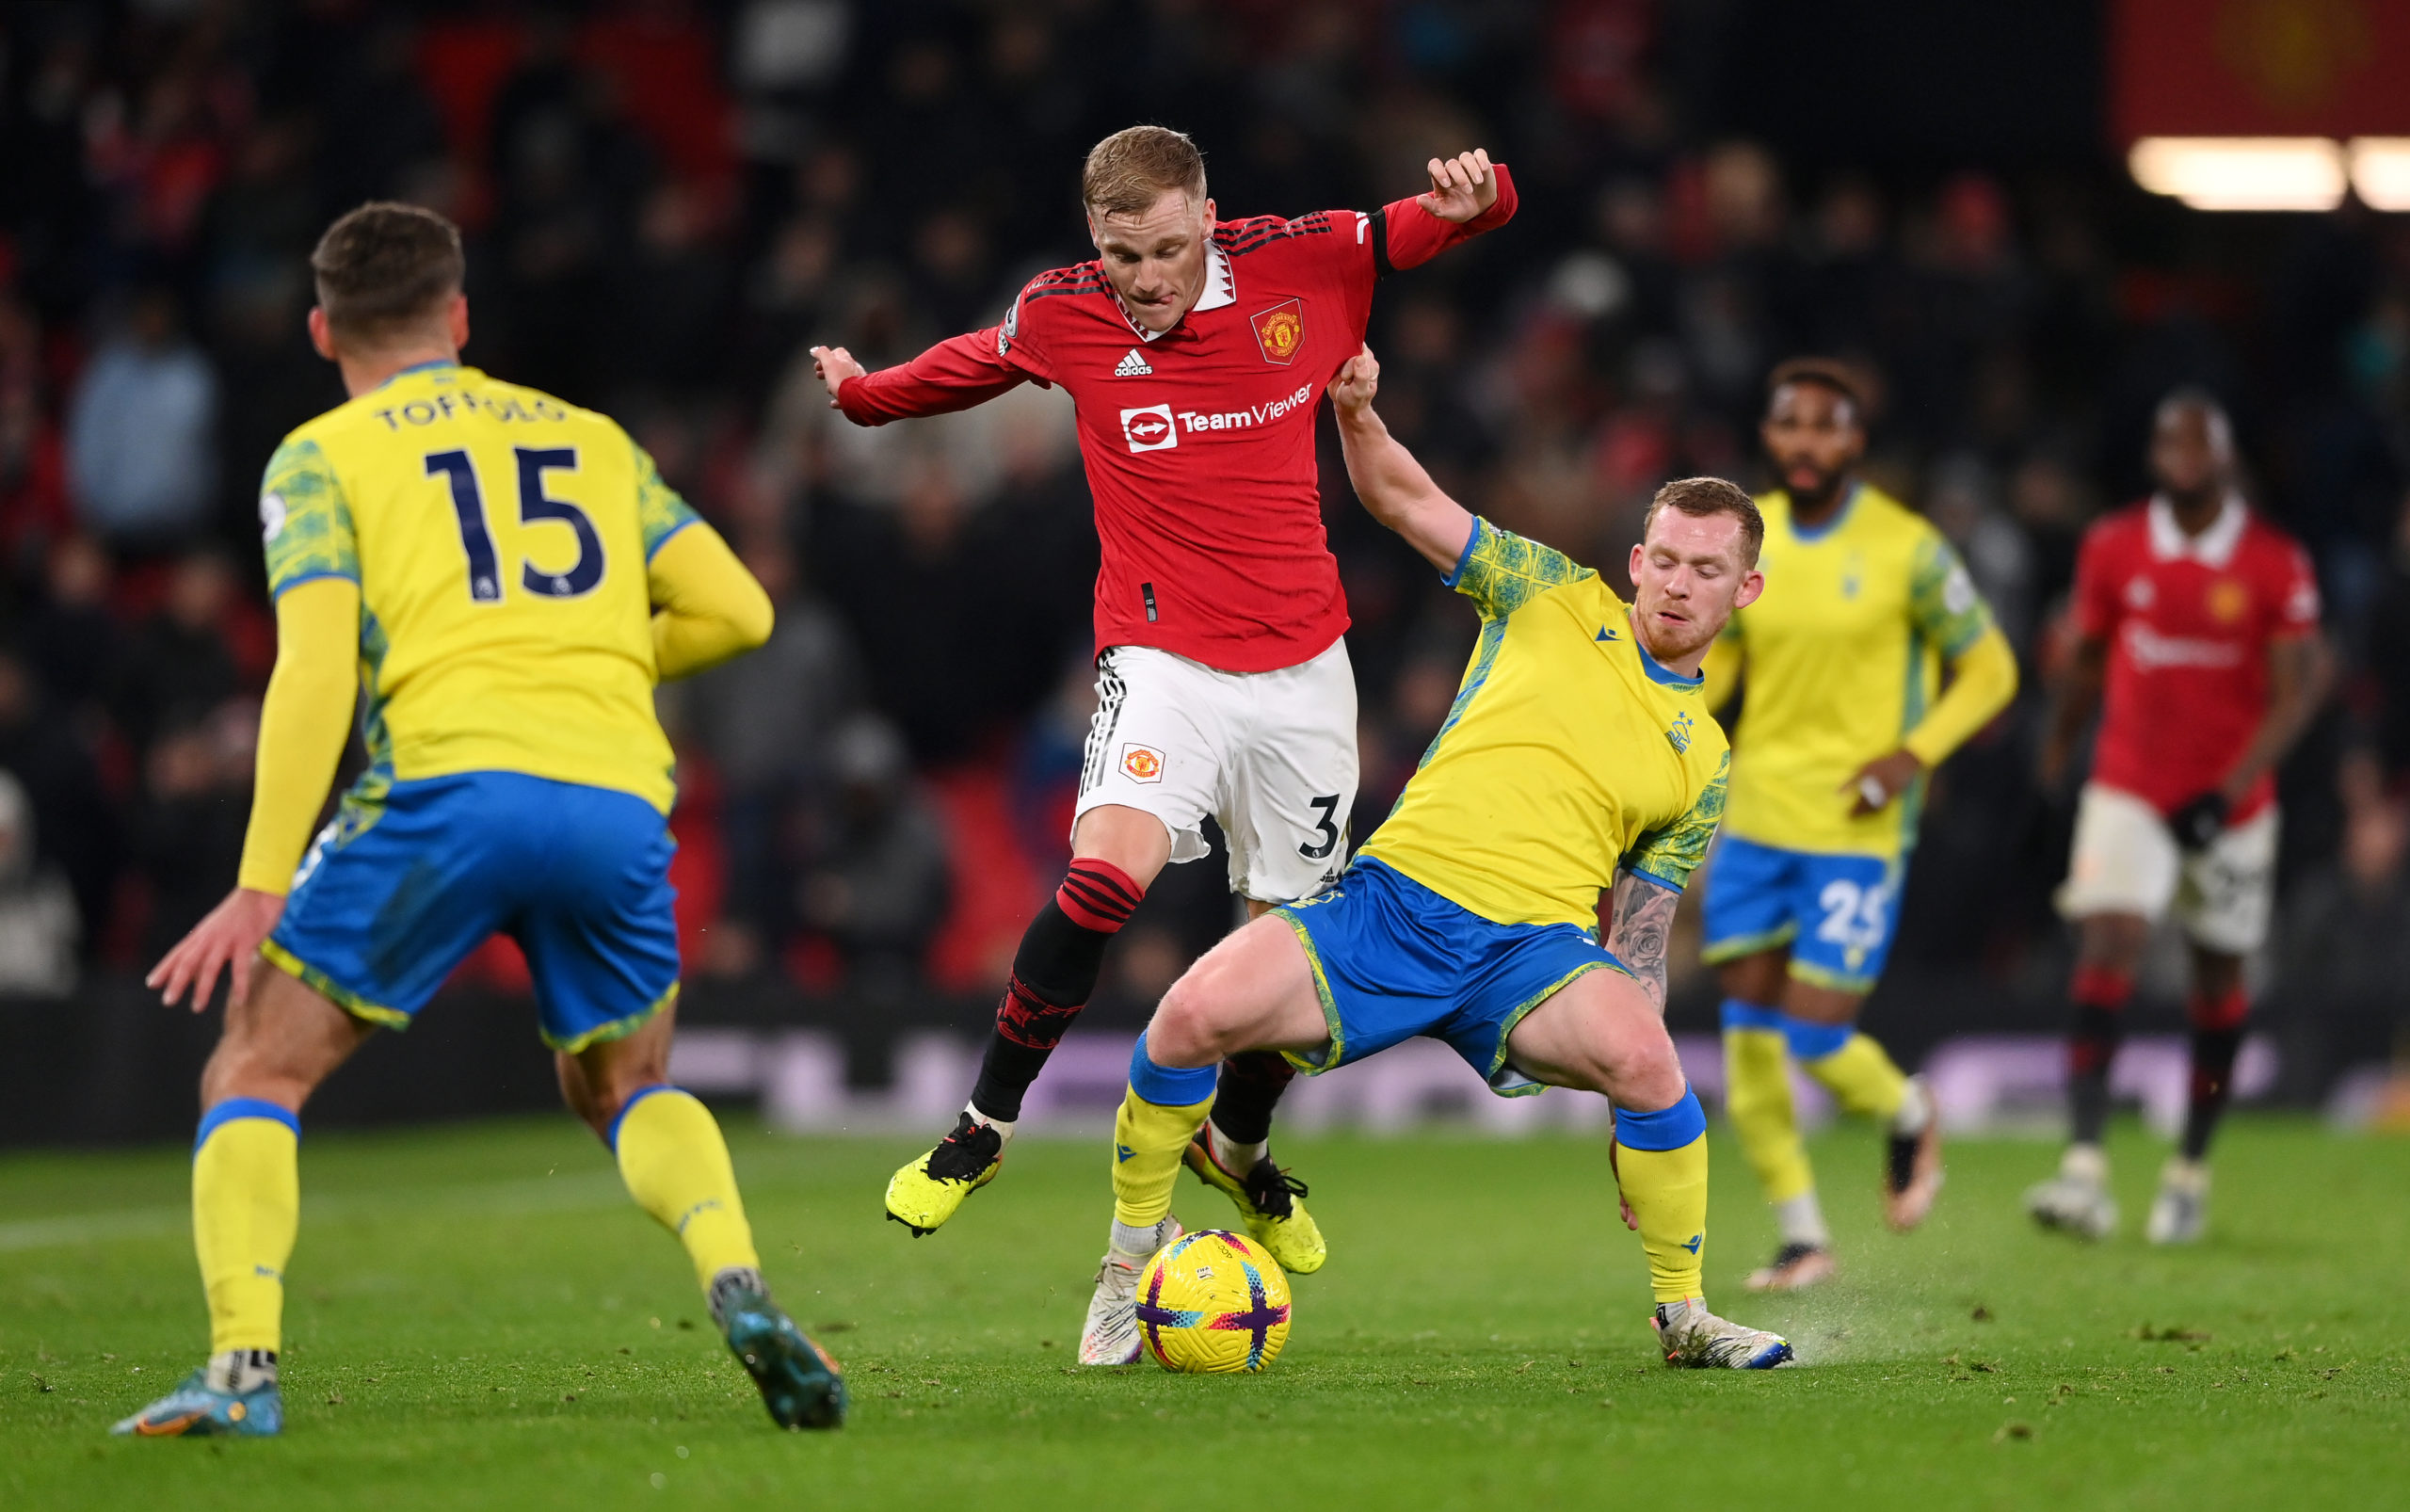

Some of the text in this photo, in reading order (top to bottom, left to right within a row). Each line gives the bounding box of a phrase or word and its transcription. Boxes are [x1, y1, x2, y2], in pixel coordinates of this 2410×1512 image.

[1115, 364, 1153, 377] adidas
[1177, 382, 1312, 433] TeamViewer
[425, 446, 605, 601] 15
[1298, 794, 1340, 859] 3
